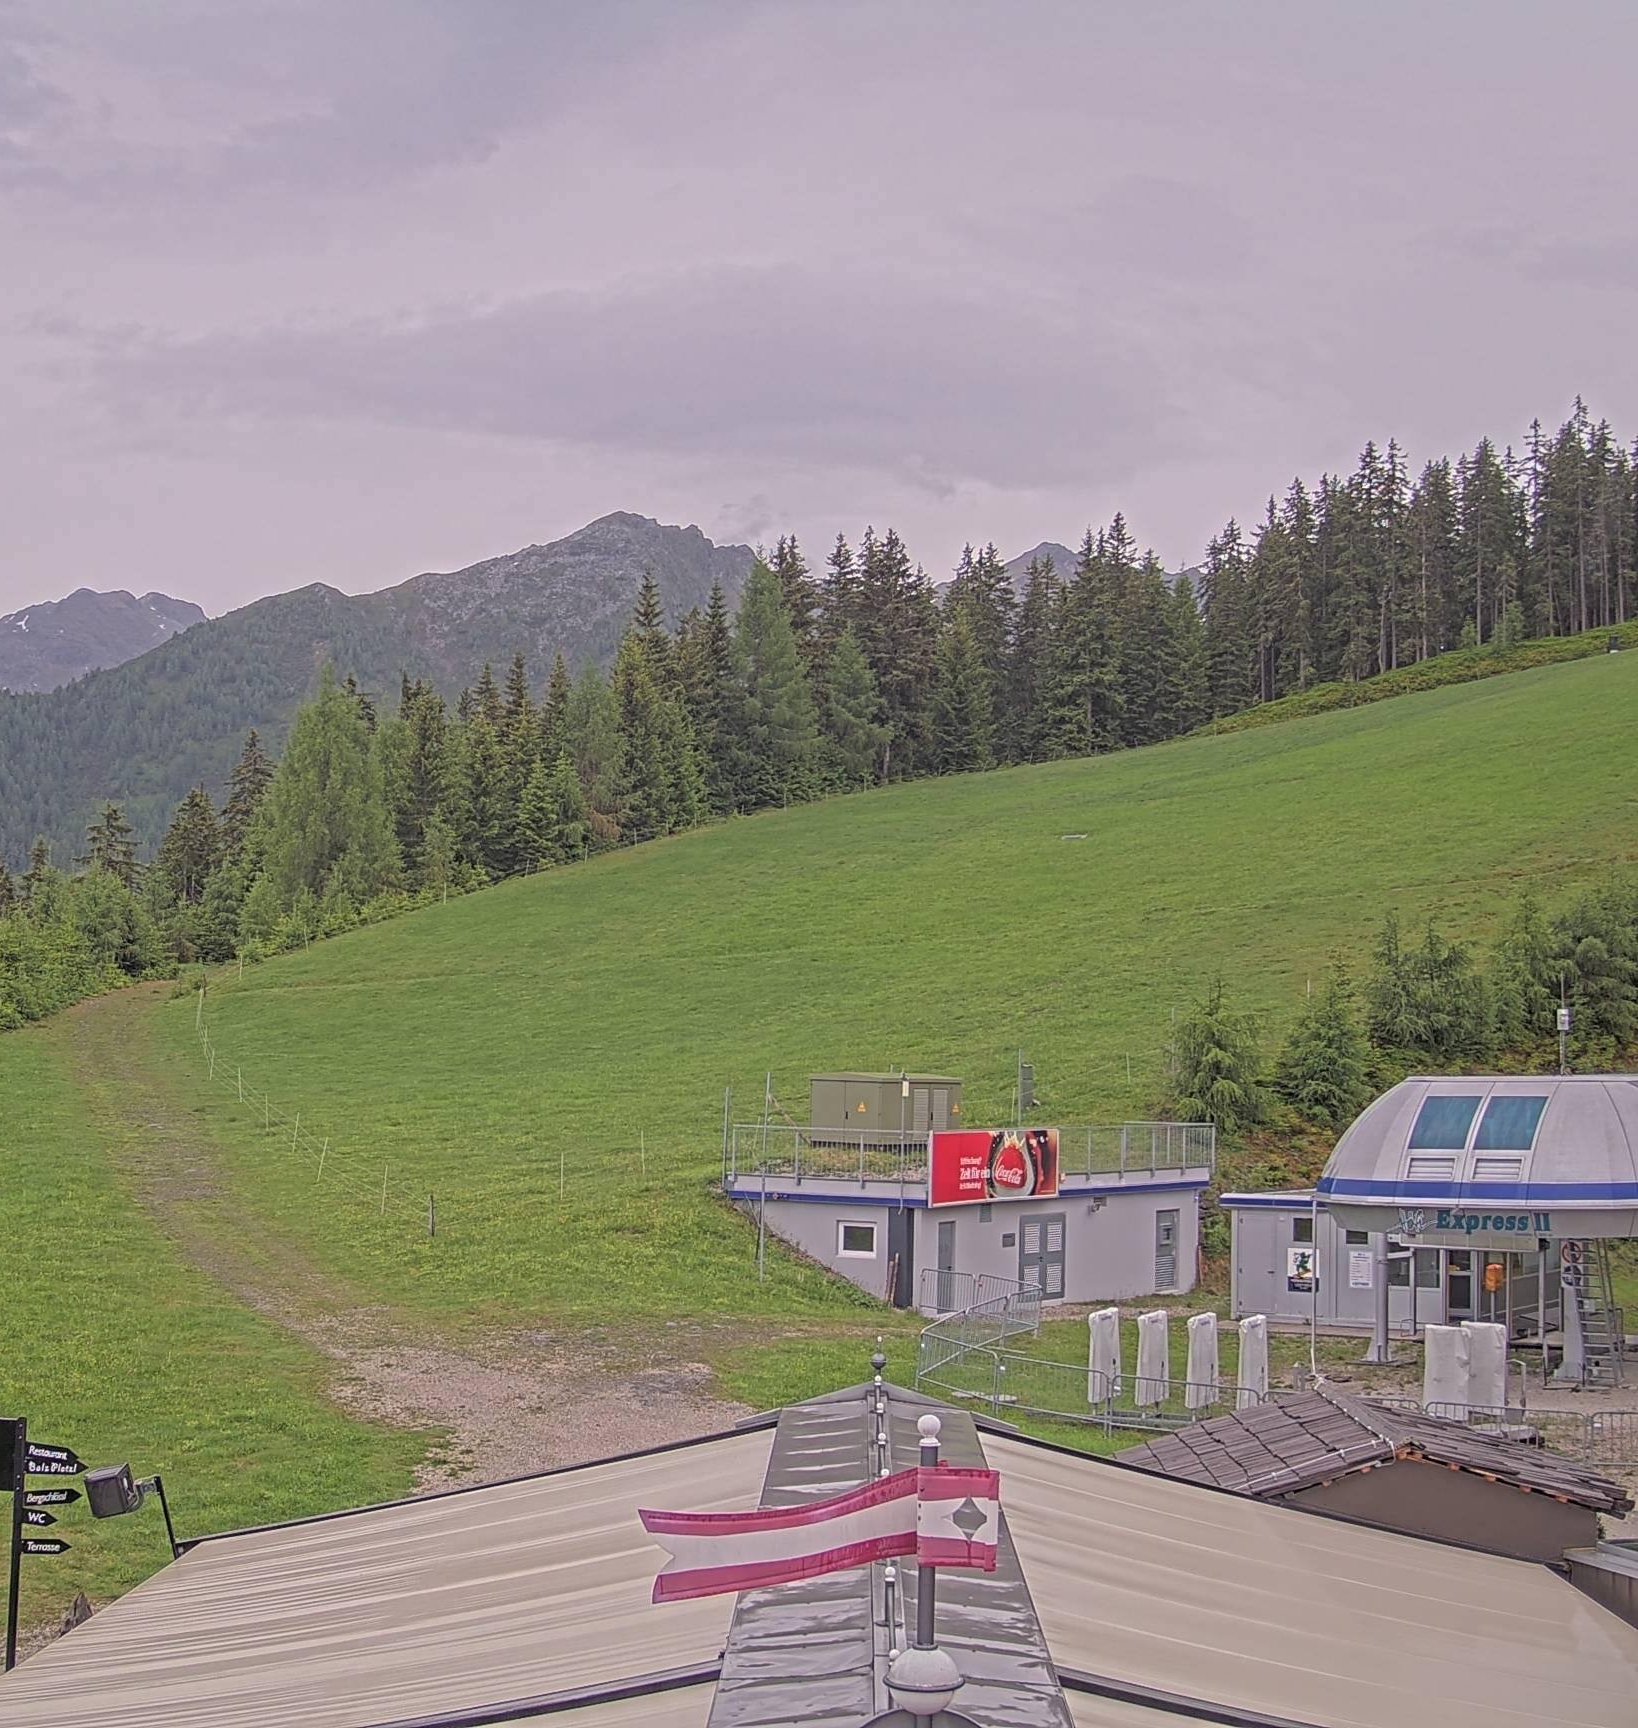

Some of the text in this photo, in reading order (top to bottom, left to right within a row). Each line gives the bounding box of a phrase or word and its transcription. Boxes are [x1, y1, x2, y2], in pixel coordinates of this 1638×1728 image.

[1436, 1209, 1529, 1234] Express
[28, 1444, 68, 1460] Restaurant
[27, 1511, 47, 1524] WC
[26, 1540, 61, 1553] Terrasse
